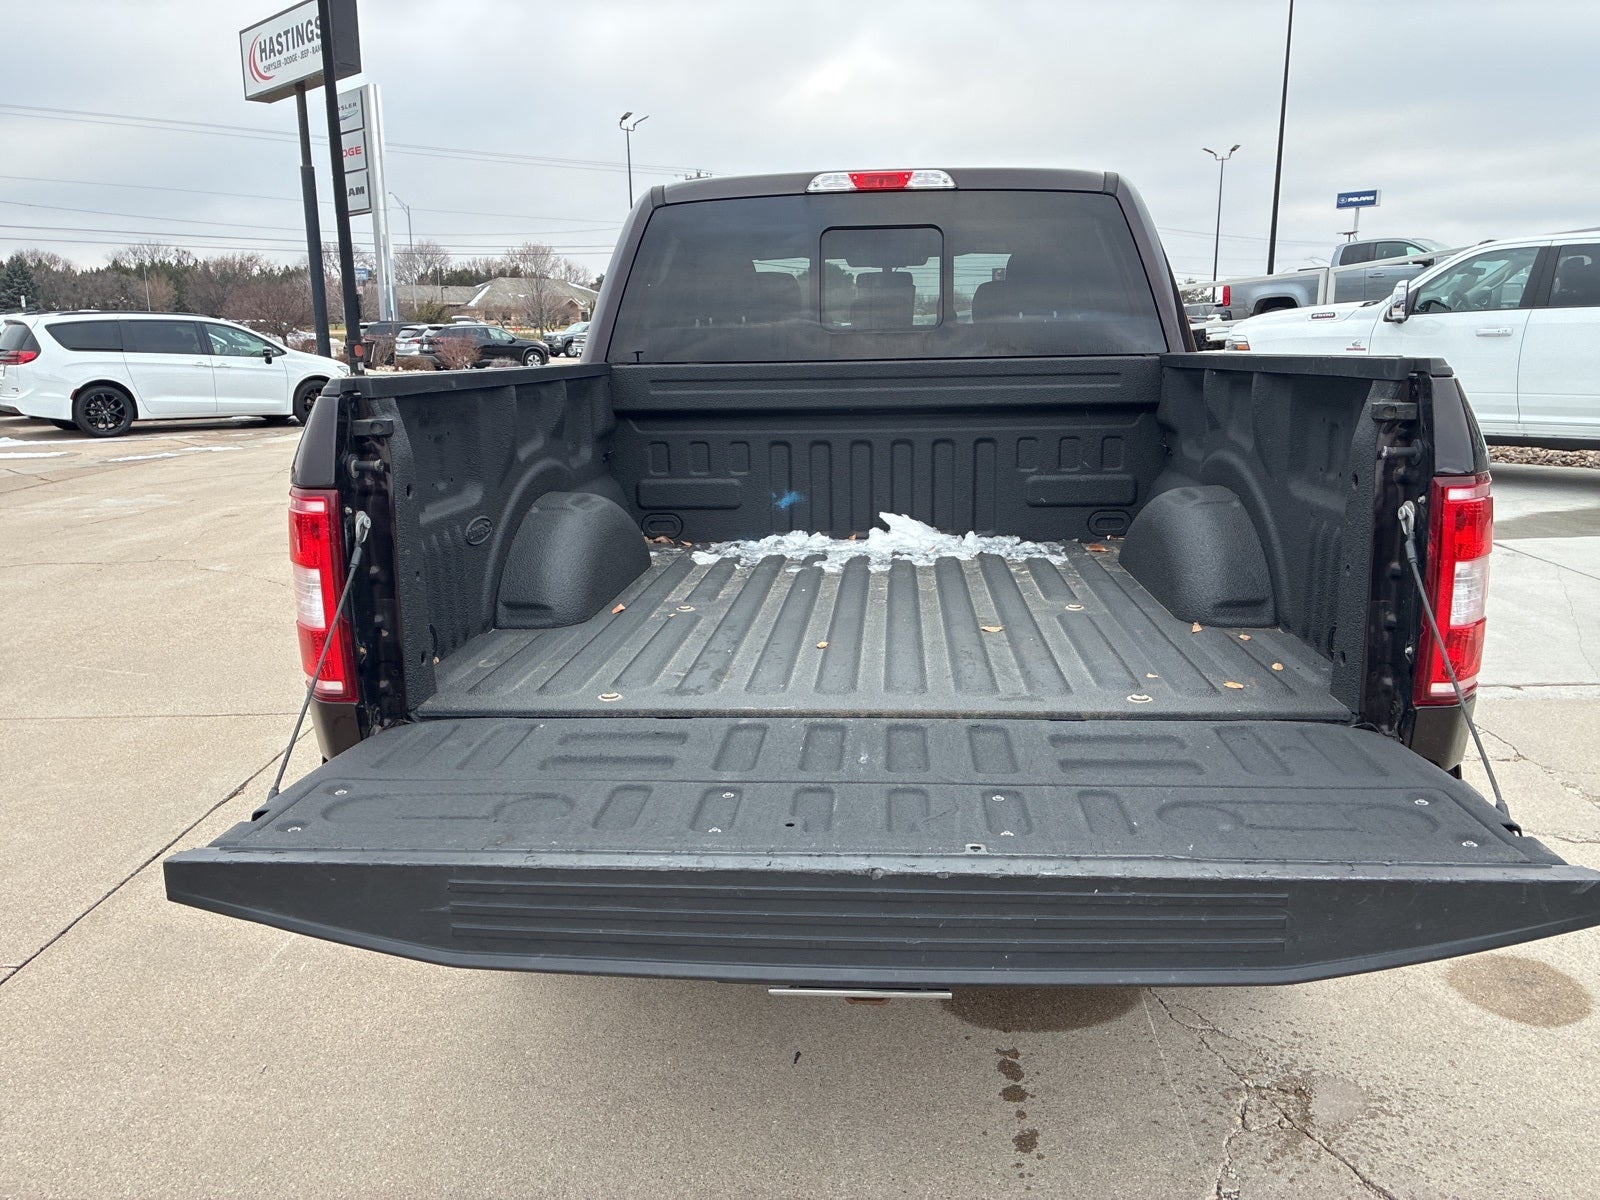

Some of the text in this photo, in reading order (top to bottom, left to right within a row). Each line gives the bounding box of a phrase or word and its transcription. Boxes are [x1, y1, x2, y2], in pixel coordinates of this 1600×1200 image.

[259, 16, 320, 62] HASTINGS
[263, 60, 281, 73] CHRYSLER
[284, 53, 298, 66] DODGE
[300, 48, 309, 59] JEEP
[347, 186, 365, 197] AM
